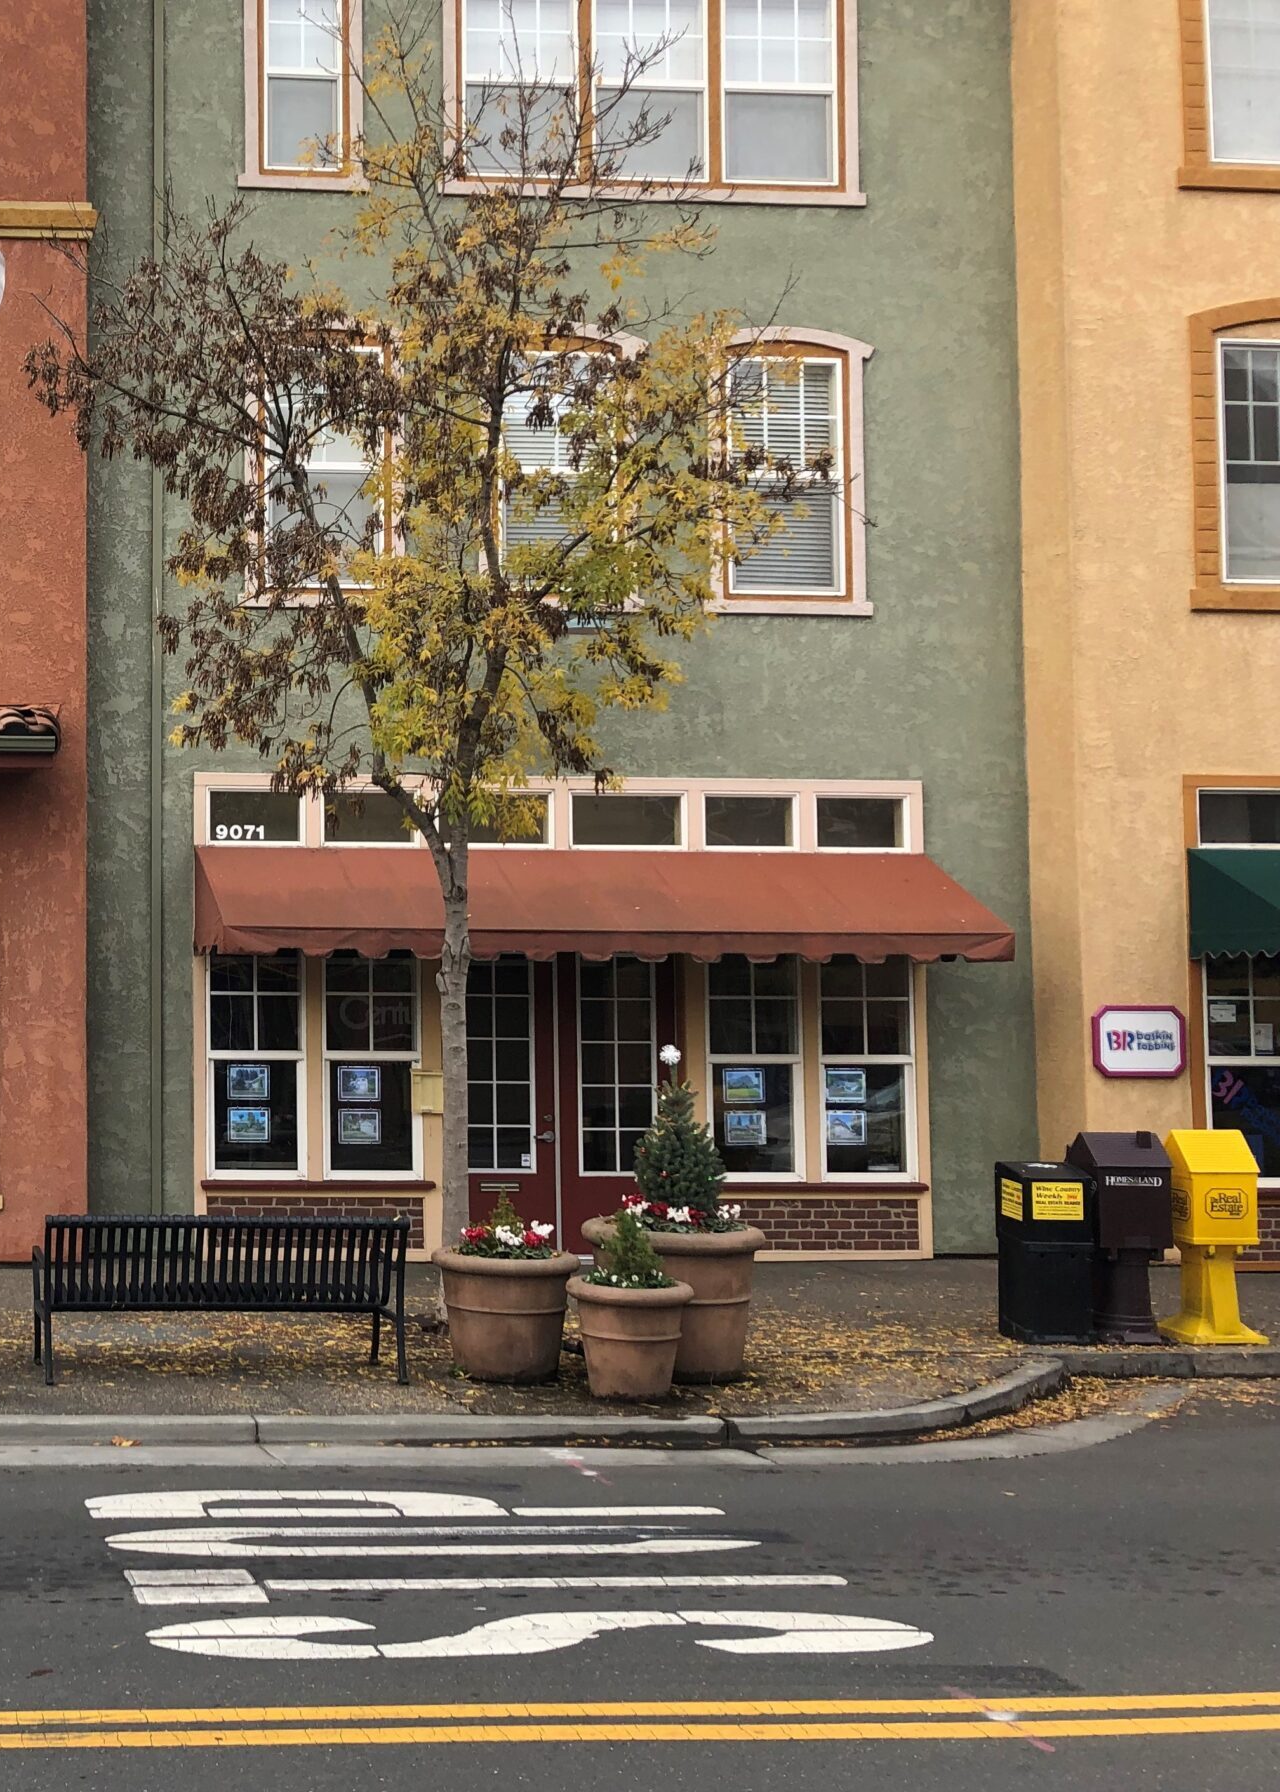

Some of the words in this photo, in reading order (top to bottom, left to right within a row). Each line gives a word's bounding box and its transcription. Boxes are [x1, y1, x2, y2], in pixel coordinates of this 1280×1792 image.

[215, 824, 265, 840] 9071
[1106, 1030, 1135, 1051] BR
[1218, 1192, 1242, 1204] Real
[1210, 1202, 1243, 1213] Estate
